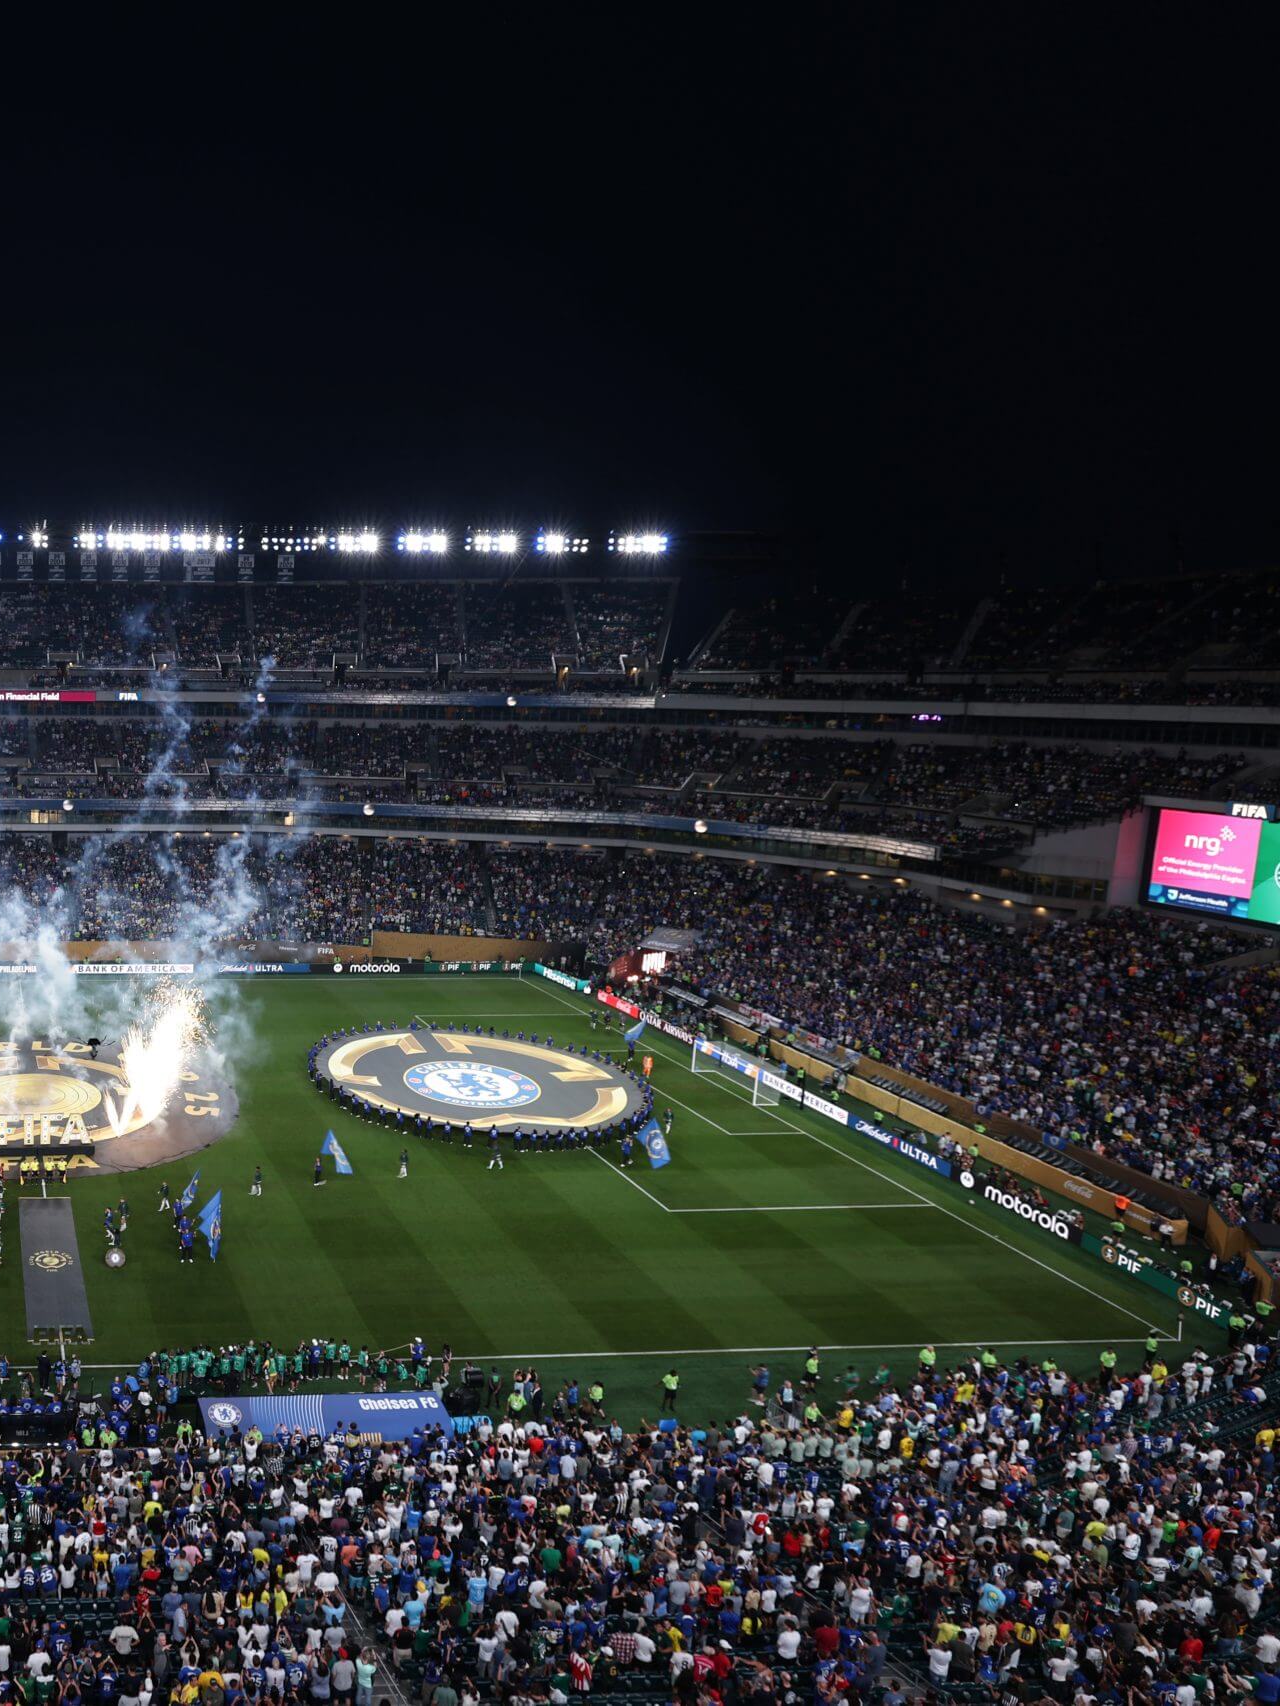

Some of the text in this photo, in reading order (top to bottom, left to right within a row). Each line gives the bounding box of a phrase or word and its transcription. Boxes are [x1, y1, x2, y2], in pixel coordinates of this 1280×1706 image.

[6, 692, 39, 701] Financial
[40, 692, 60, 701] Field
[119, 692, 138, 701] FIFA
[1232, 803, 1268, 819] FIFA
[1162, 857, 1244, 874] Official Energy Provider
[1179, 868, 1221, 881] Philadelphia
[1221, 874, 1246, 885] Eagles
[78, 965, 176, 973] BANK OF AMERICA
[350, 964, 400, 973] motorola
[543, 967, 576, 990] Hisense
[639, 1010, 693, 1045] QATAR AIRWAYS
[415, 1062, 493, 1075] CHELSEA
[764, 1073, 785, 1091] BANK
[786, 1084, 797, 1098] OF
[442, 1095, 531, 1107] FOOTBALL CLUB
[855, 1119, 939, 1170] Michelob ULTRA
[984, 1184, 1069, 1241] motorola
[1117, 1253, 1143, 1274] PIF
[1195, 1296, 1222, 1319] PIF
[358, 1397, 439, 1411] Chelsea FC
[23, 1577, 35, 1586] 25
[41, 1570, 53, 1583] 25
